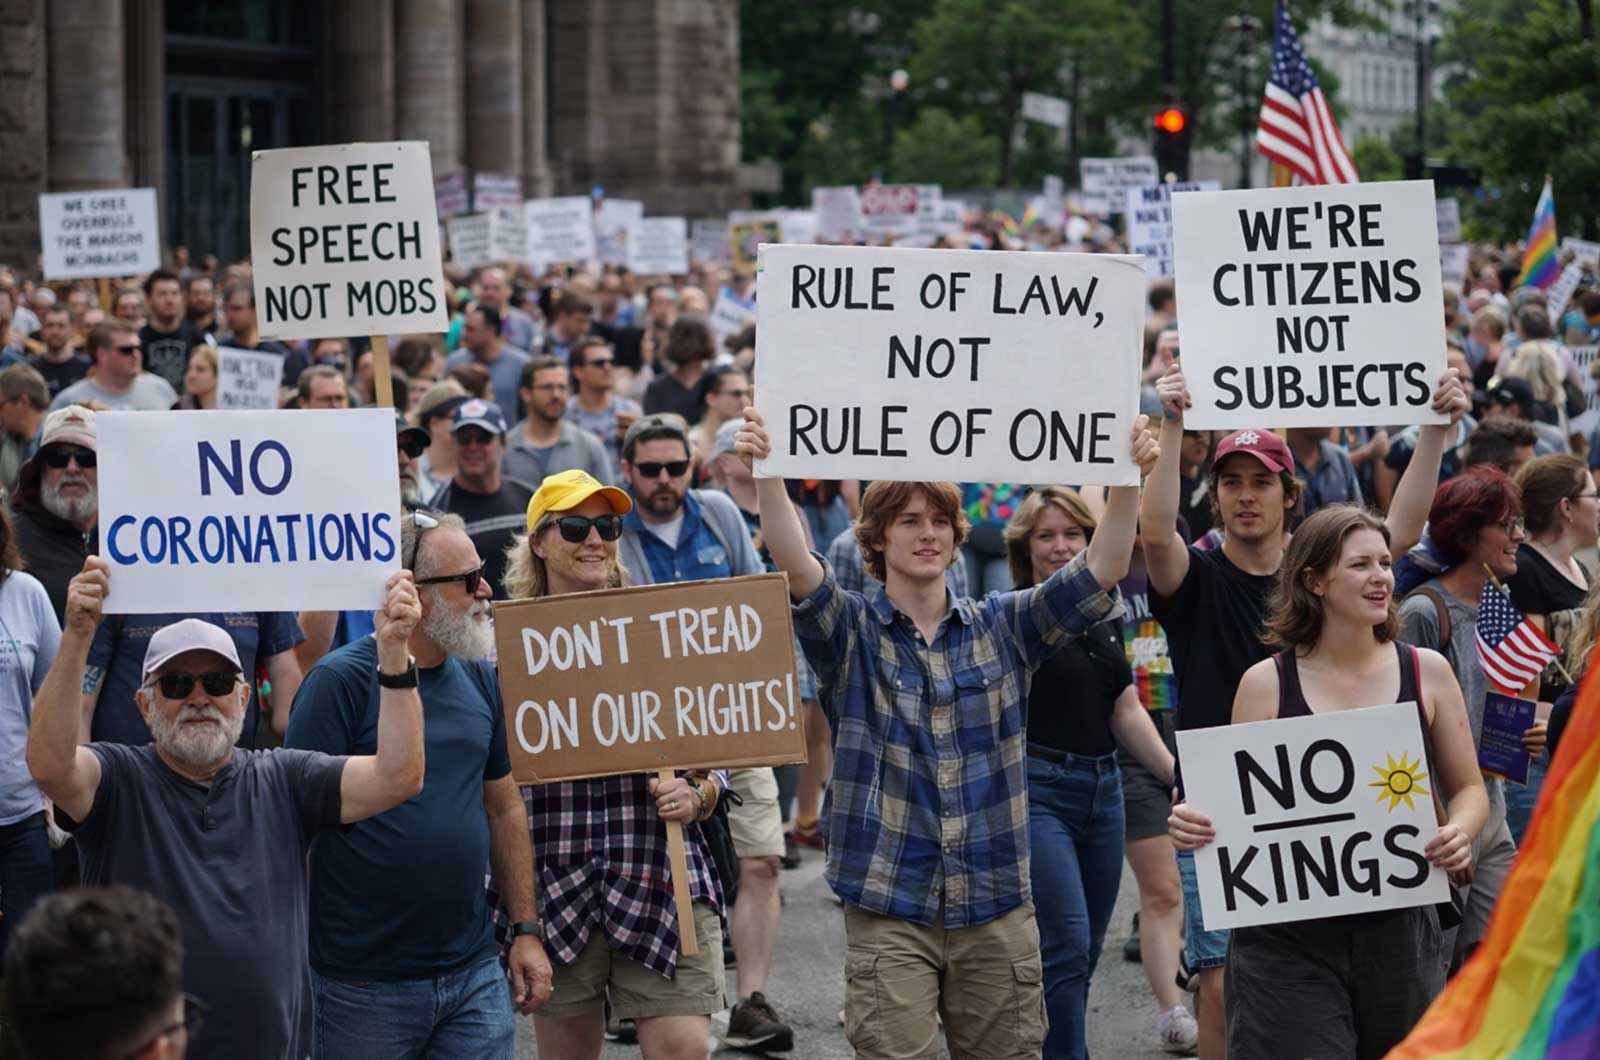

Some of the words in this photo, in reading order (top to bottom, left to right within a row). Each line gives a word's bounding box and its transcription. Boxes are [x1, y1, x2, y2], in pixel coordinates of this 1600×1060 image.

[292, 164, 396, 207] FREE
[272, 221, 421, 266] SPEECH
[1239, 202, 1384, 251] WE'RE
[266, 283, 331, 322] NOT
[347, 278, 436, 317] MOBS
[792, 265, 894, 310] RULE
[920, 272, 970, 312] OF
[993, 273, 1103, 328] LAW,
[1214, 259, 1421, 306] CITIZENS
[888, 335, 990, 381] NOT
[1277, 315, 1349, 353] NOT
[1214, 362, 1431, 410] SUBJECTS
[790, 404, 907, 457] RULE
[930, 409, 992, 457] OF
[1009, 409, 1115, 463] ONE
[198, 440, 292, 495] NO
[107, 513, 395, 565] CORONATIONS
[522, 617, 633, 675] DON'T
[650, 604, 761, 658] TREAD
[516, 698, 579, 754] ON
[592, 691, 666, 746] OUR
[674, 674, 796, 736] RIGHTS!
[1234, 739, 1355, 815] NO
[1218, 824, 1430, 911] KINGS
